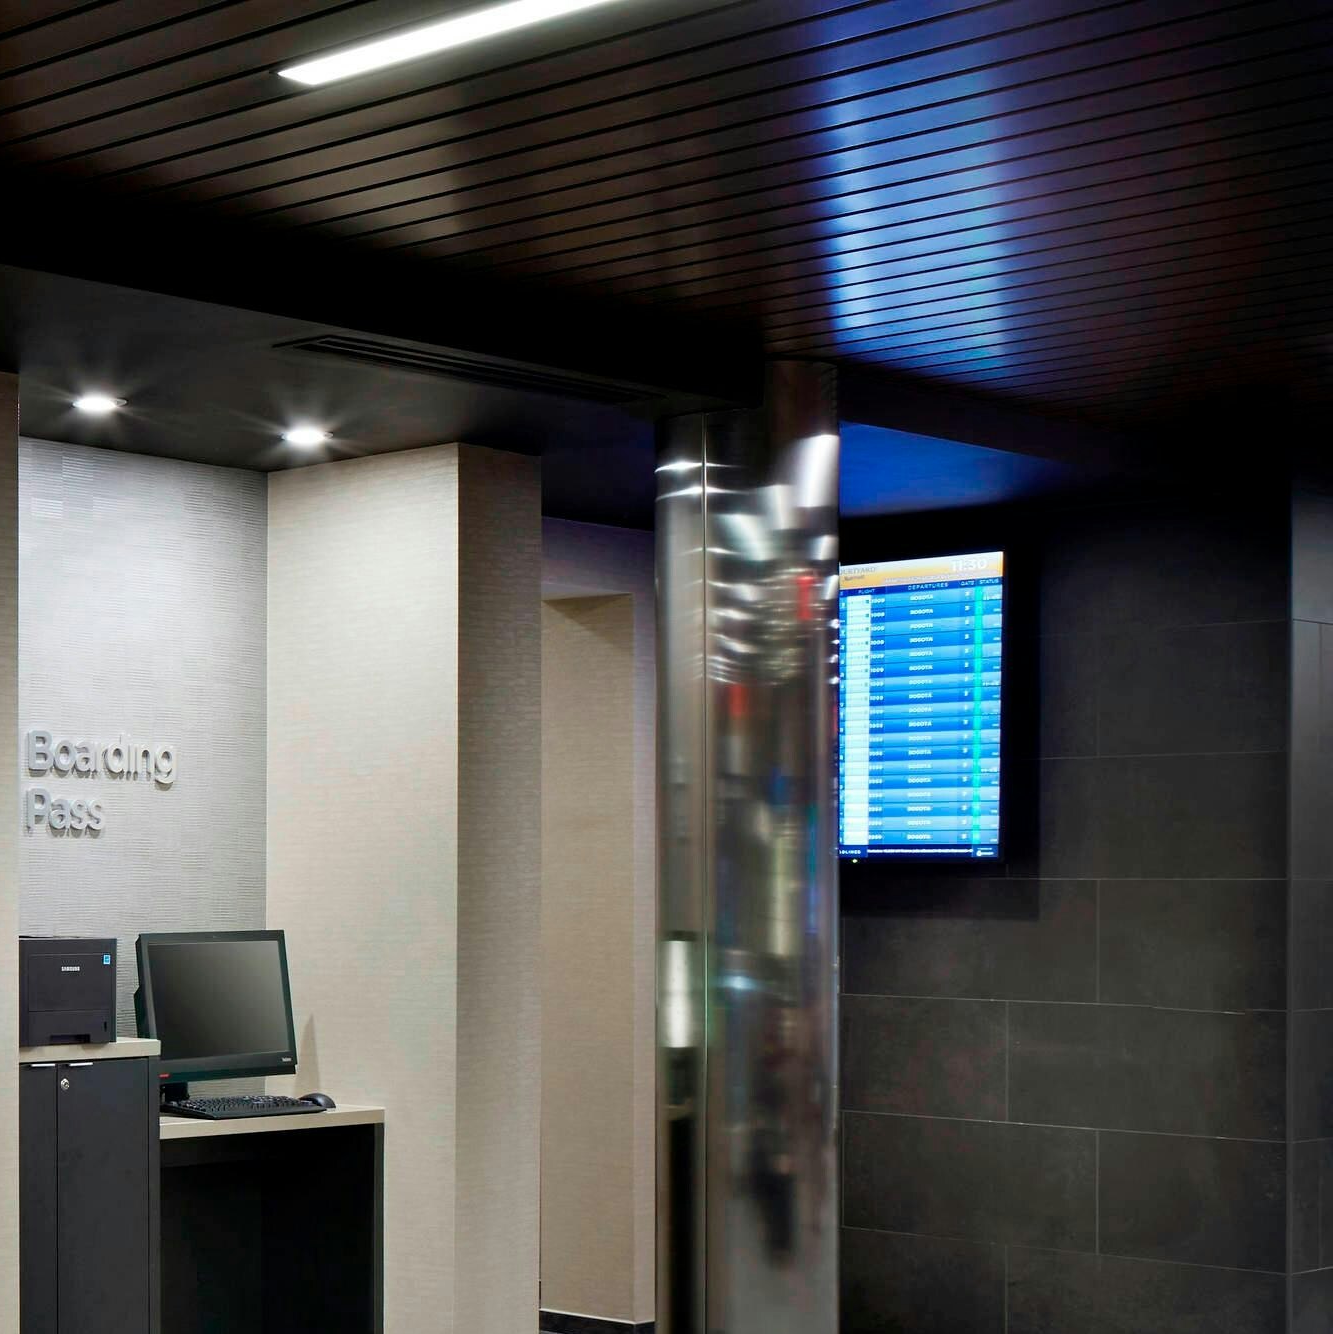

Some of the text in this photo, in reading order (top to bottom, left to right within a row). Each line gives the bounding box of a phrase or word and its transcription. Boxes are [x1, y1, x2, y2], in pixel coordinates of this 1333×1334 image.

[907, 582, 949, 591] DEPARTURES
[28, 730, 177, 784] Boarding
[27, 788, 103, 830] Pass
